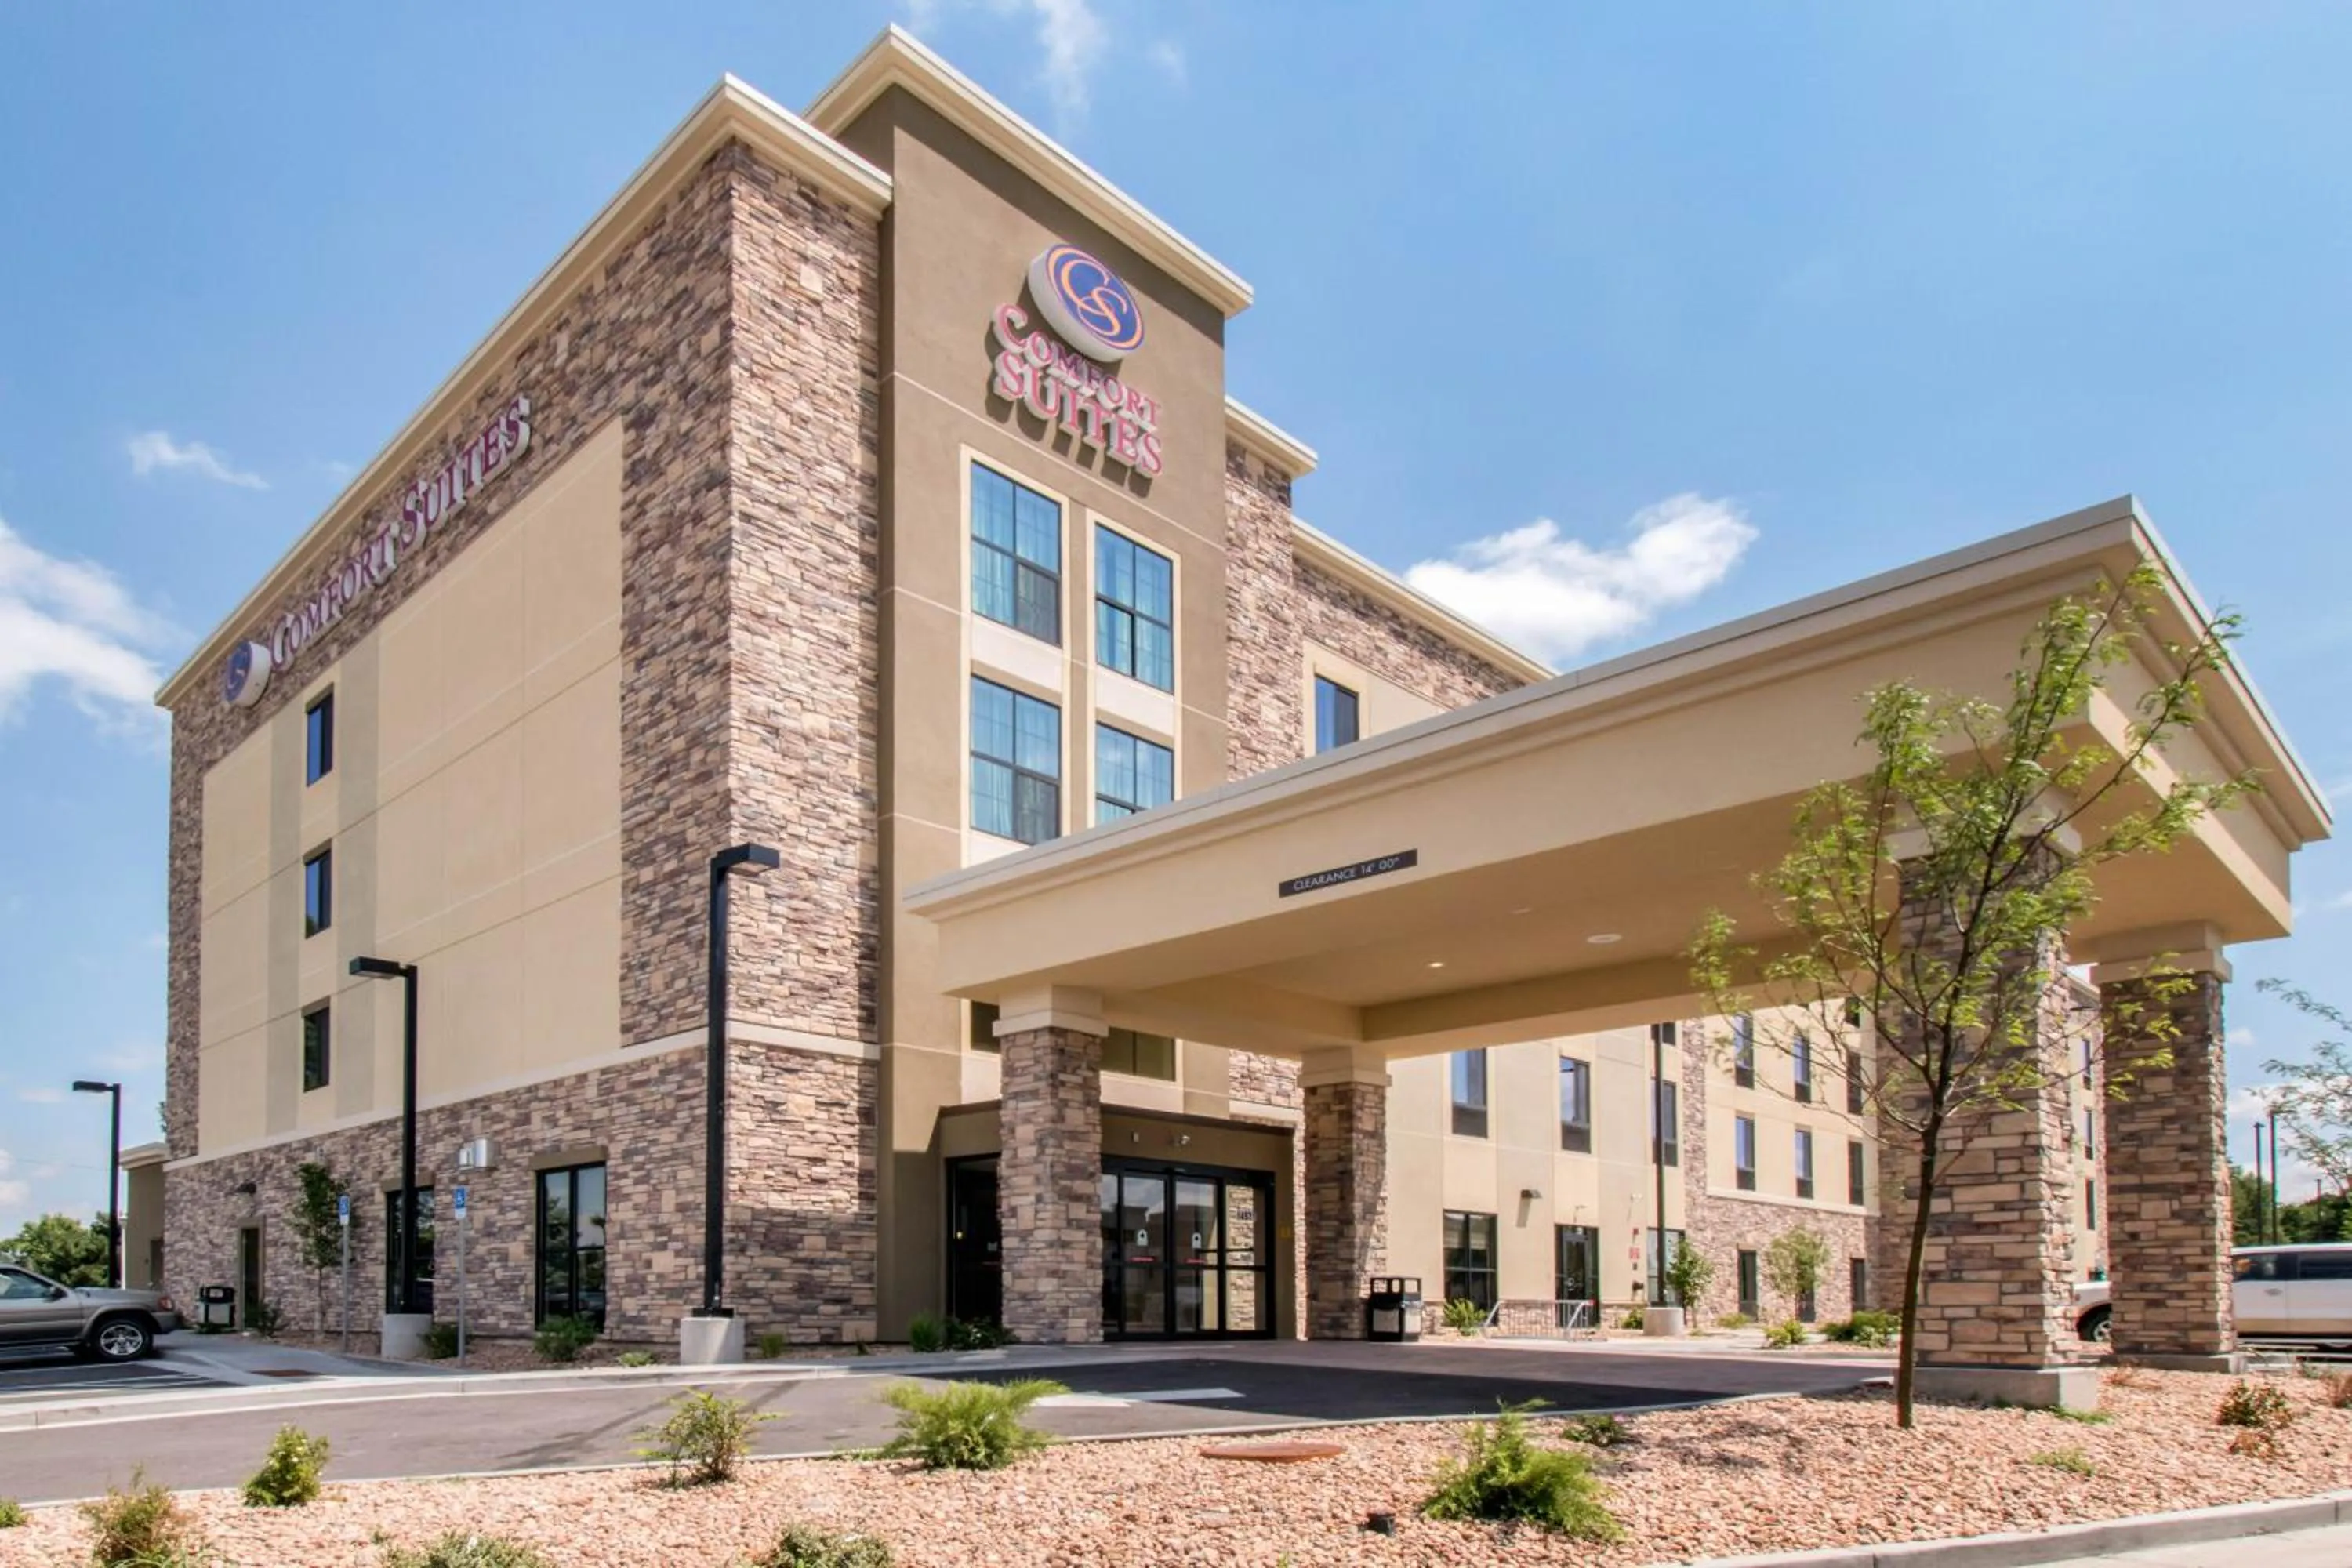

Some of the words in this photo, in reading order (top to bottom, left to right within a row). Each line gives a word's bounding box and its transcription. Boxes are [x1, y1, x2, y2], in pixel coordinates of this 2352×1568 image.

[993, 303, 1163, 430] COMFORT
[994, 350, 1162, 477] SUITES
[270, 521, 398, 671] COMFORT
[400, 395, 531, 552] SUITES
[1294, 868, 1356, 891] CLEARANCE
